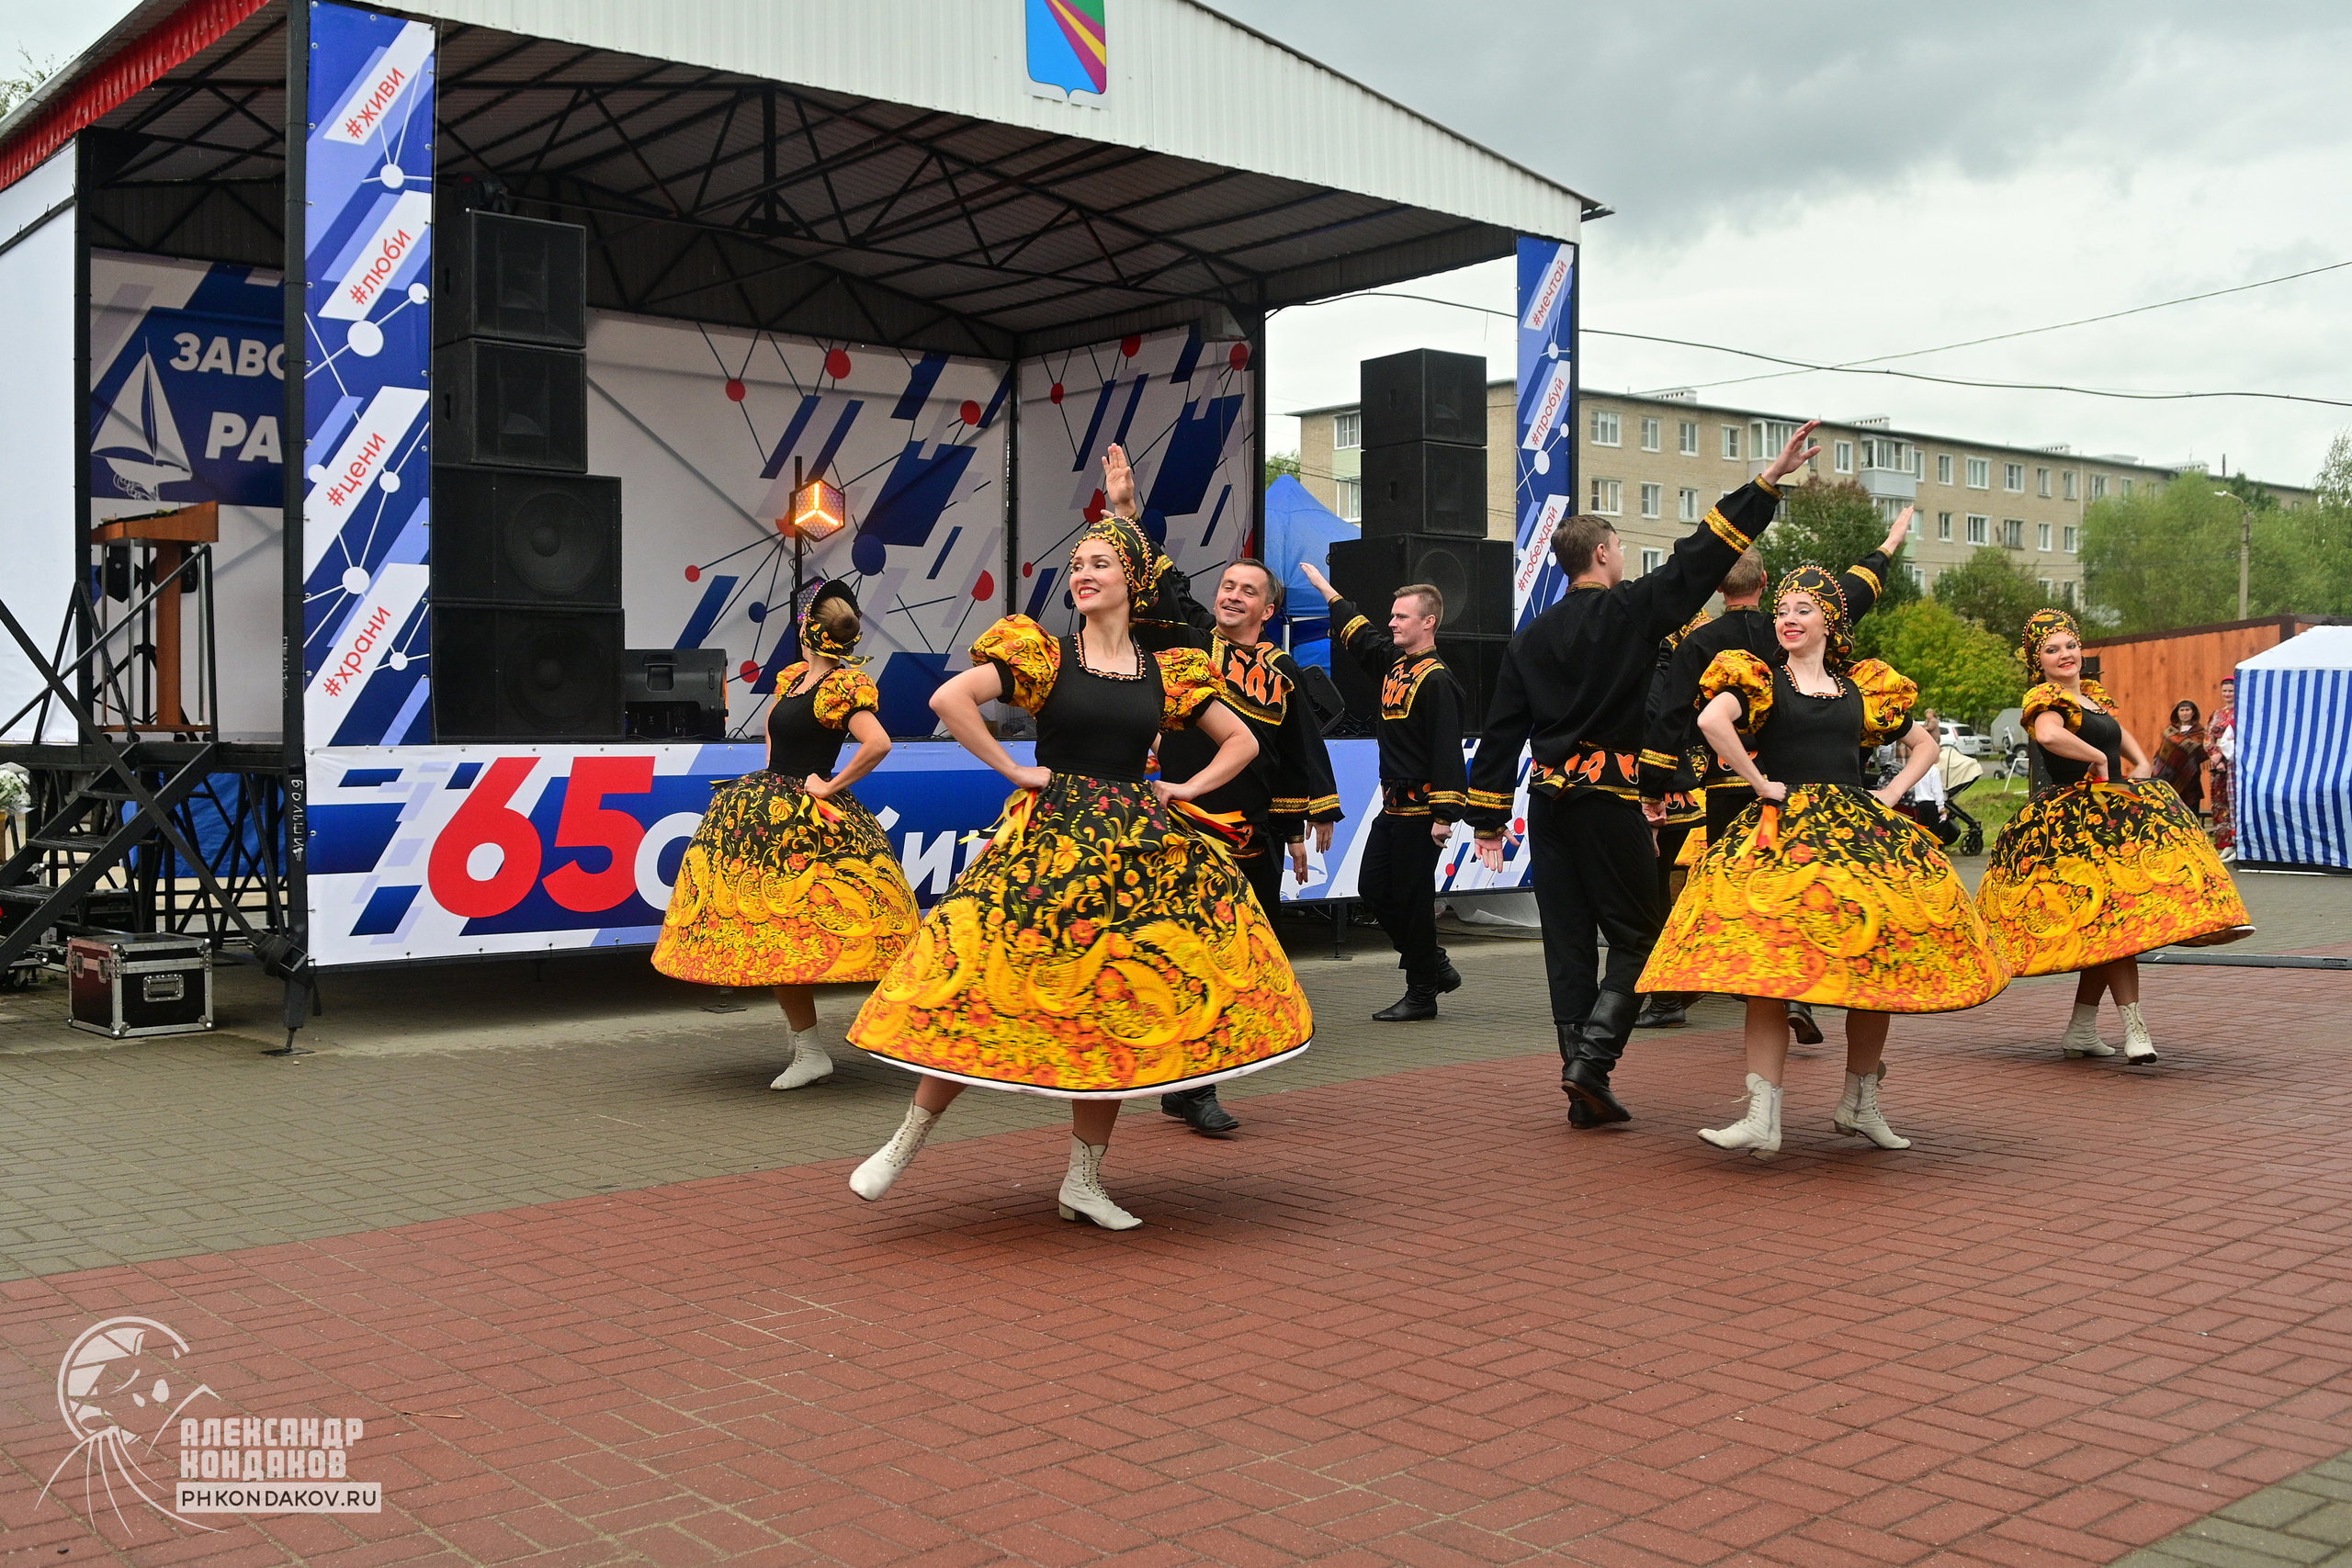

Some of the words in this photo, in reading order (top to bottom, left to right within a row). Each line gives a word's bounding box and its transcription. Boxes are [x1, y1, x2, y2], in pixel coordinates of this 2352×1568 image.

[345, 67, 405, 139] #живи
[349, 229, 412, 306] #люби
[1533, 259, 1567, 327] #мечтай
[1531, 378, 1565, 446] #пробуй
[327, 432, 387, 506] #цени
[1518, 505, 1558, 592] #побеждай
[322, 604, 392, 698] #храни
[427, 756, 655, 919] 65
